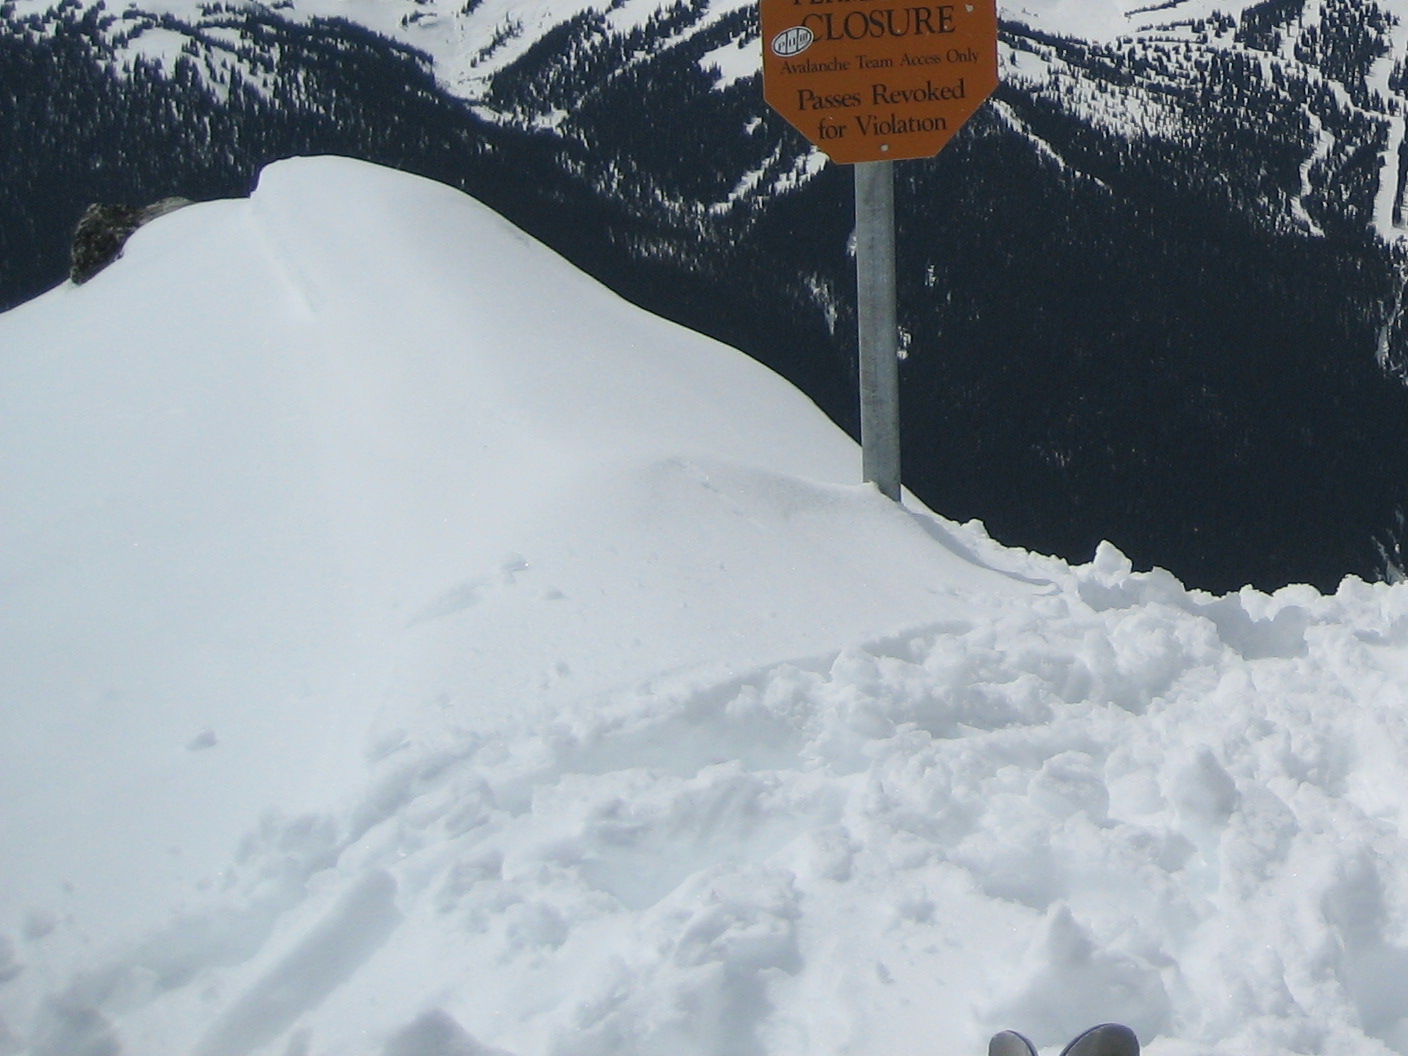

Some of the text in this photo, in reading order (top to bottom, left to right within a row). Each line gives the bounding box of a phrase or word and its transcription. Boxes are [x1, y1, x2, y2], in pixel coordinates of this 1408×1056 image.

[802, 5, 957, 43] CLOSURE
[781, 48, 979, 75] Avalanche Team Access Only
[796, 78, 966, 111] Passes Revoked
[818, 113, 948, 140] for Violation
